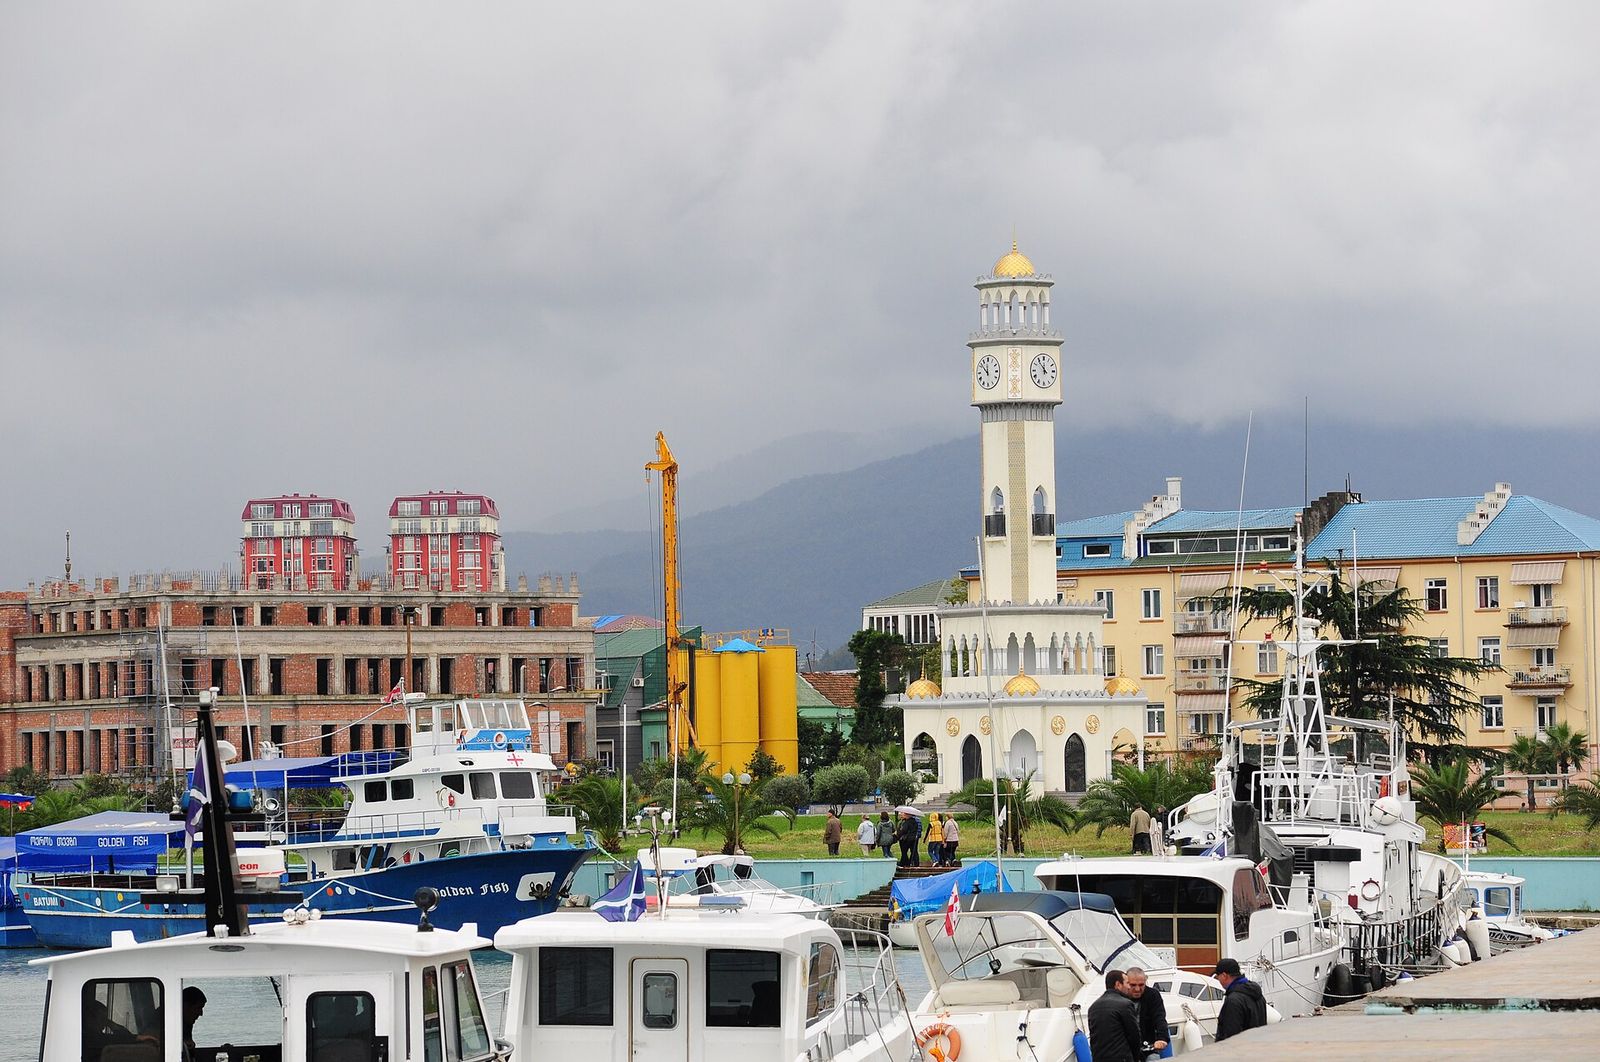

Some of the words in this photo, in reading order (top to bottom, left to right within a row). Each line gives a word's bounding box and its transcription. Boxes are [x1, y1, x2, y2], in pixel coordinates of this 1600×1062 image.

[98, 837, 125, 847] GOLDEN
[133, 836, 148, 846] FISH
[434, 886, 474, 897] olden
[480, 882, 509, 895] Fish
[33, 896, 58, 906] BATUMI
